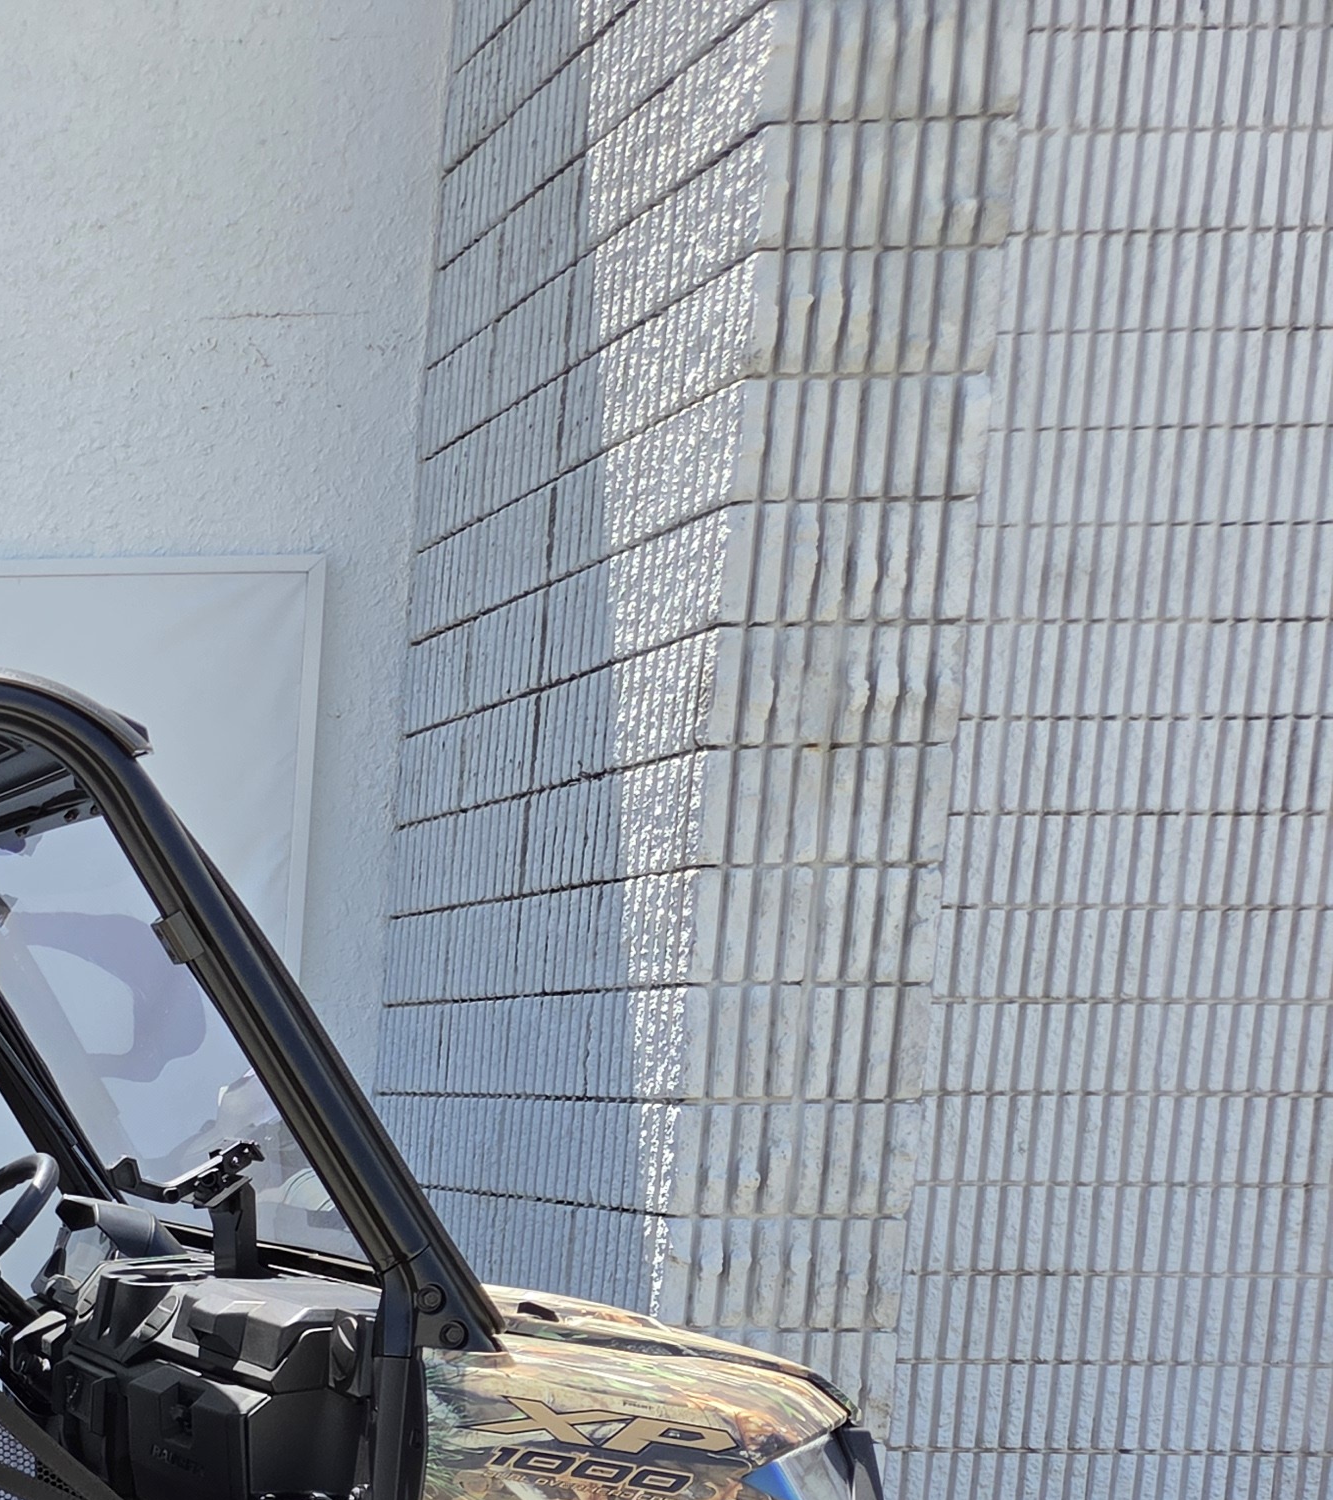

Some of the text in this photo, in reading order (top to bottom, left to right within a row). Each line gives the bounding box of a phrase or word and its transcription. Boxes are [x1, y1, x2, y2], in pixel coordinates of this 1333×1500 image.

[457, 1394, 740, 1455] XP
[481, 1469, 529, 1483] DUAL
[534, 1477, 637, 1500] OVERHEAD
[487, 1445, 694, 1495] 1000
